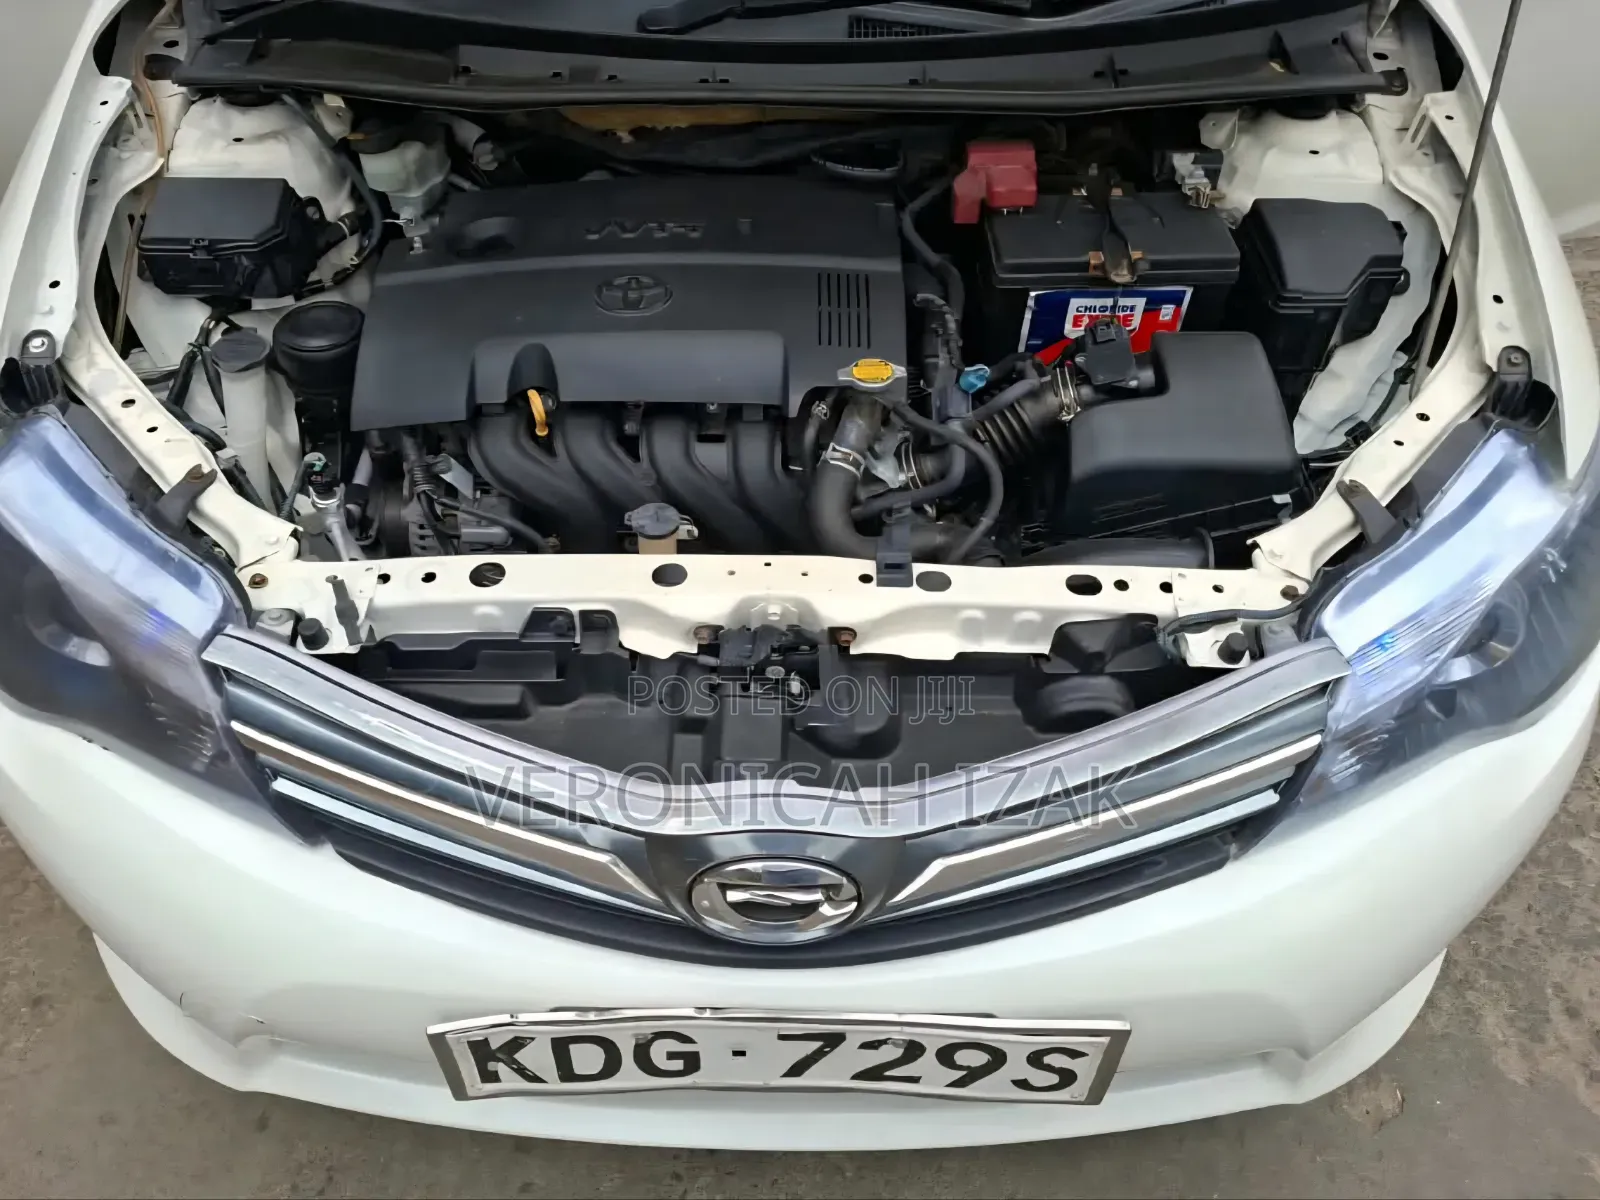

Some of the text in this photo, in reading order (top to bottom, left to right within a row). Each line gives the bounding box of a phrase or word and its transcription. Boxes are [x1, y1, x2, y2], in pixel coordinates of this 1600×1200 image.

[1075, 305, 1137, 314] CHLOIDE
[468, 1031, 1090, 1092] KDG 729S
